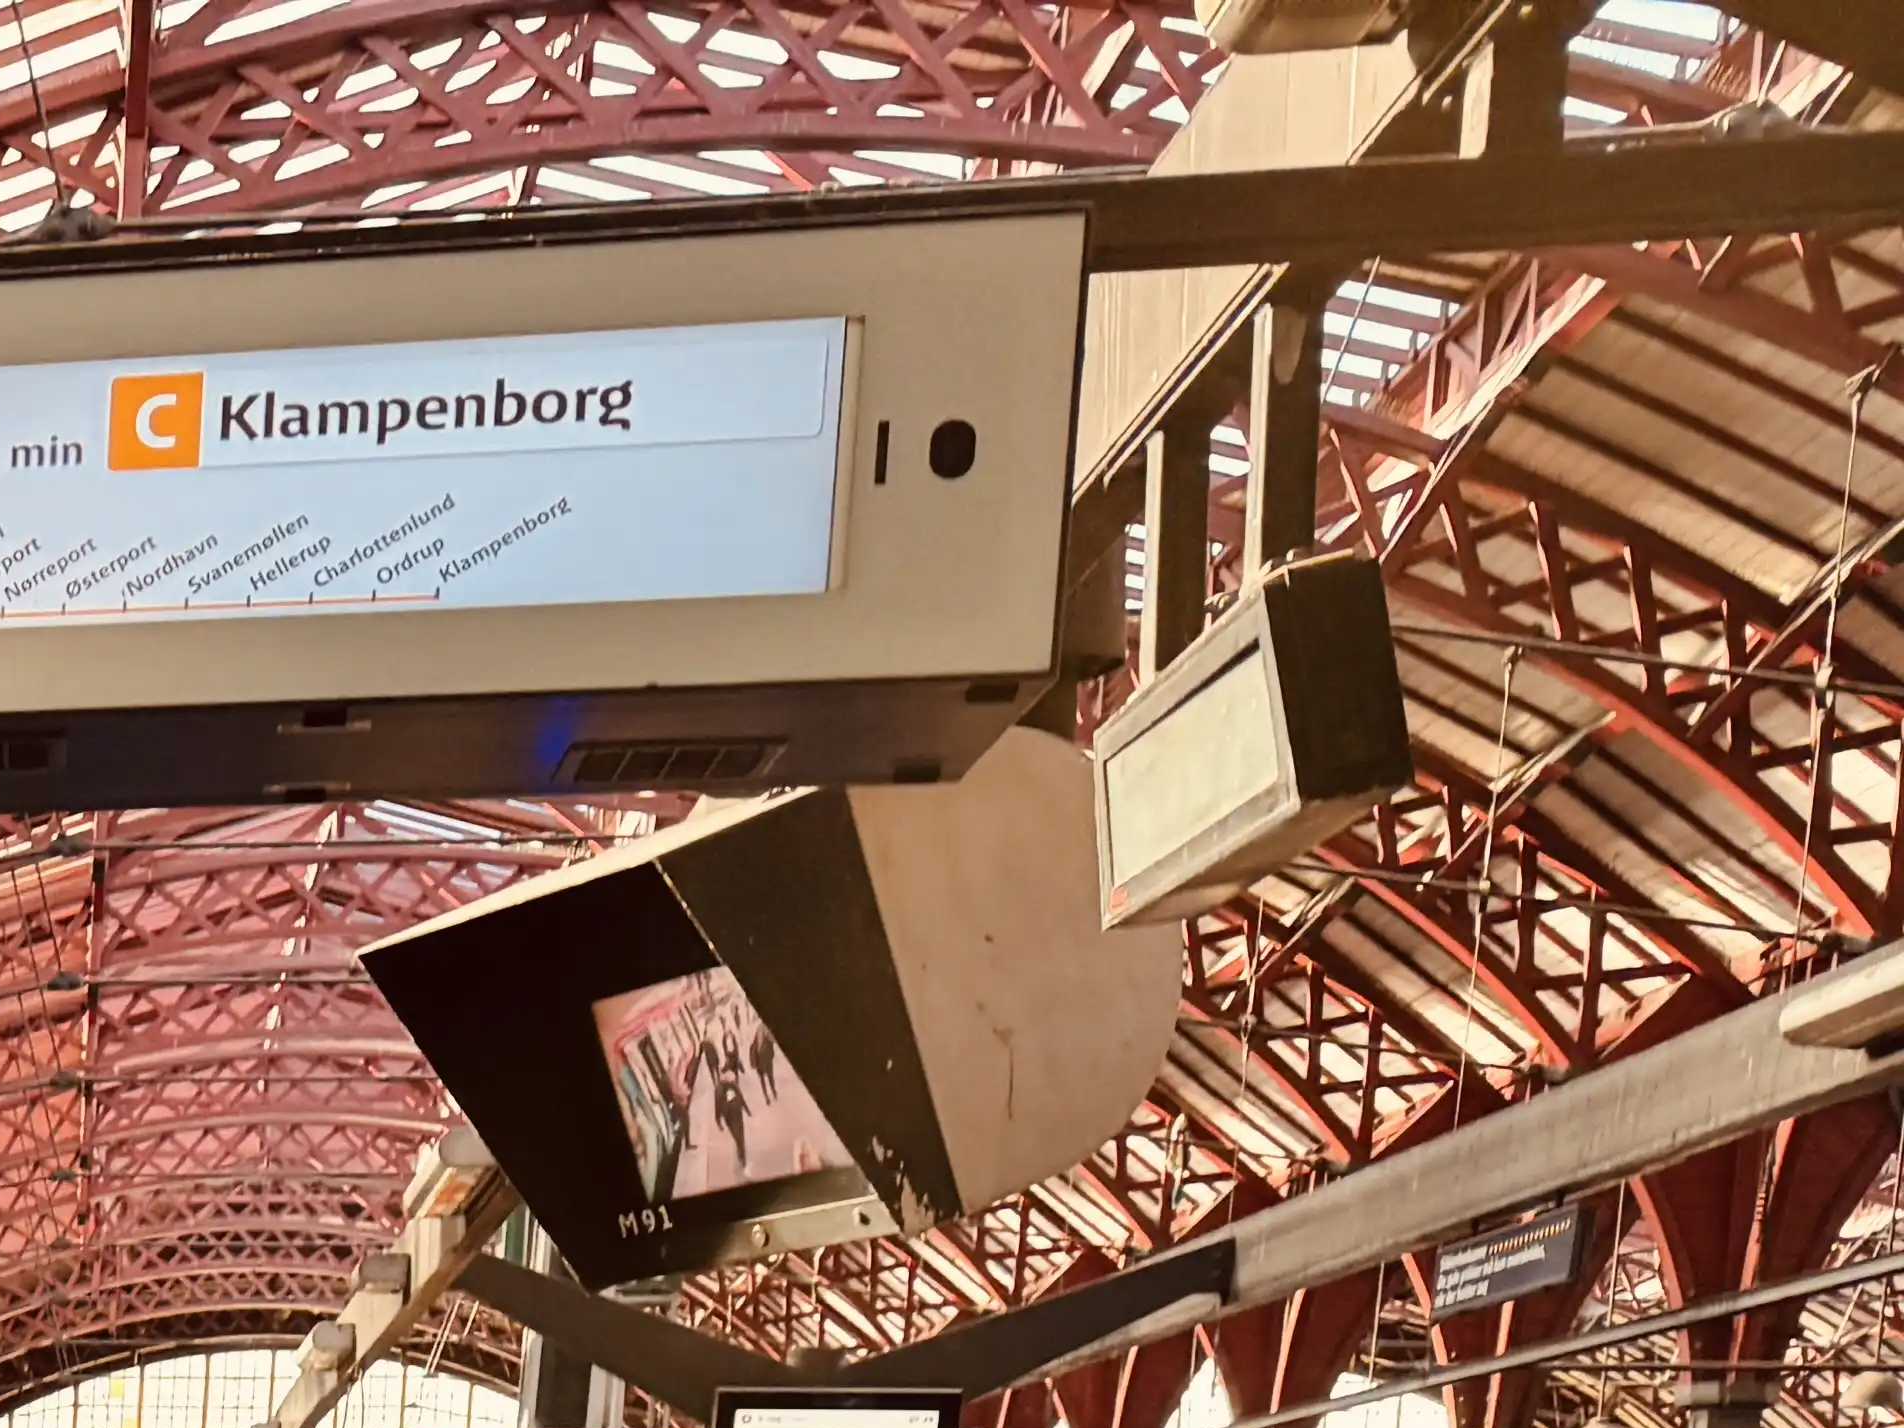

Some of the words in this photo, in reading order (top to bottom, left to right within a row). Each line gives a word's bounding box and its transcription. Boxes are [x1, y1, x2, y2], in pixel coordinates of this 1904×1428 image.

[10, 435, 83, 468] min
[134, 392, 177, 449] C
[219, 376, 634, 446] Klampenborg
[3, 537, 97, 603] Nørreport
[65, 535, 158, 600] Østerport
[125, 532, 219, 598] Nordhavn
[188, 512, 310, 596] Svanemøllen
[249, 534, 332, 592] Hellerup
[313, 493, 456, 588] Charlottenlund
[376, 536, 446, 585] Ordrup
[438, 497, 572, 584] Klampenborg
[618, 1204, 673, 1239] M91
